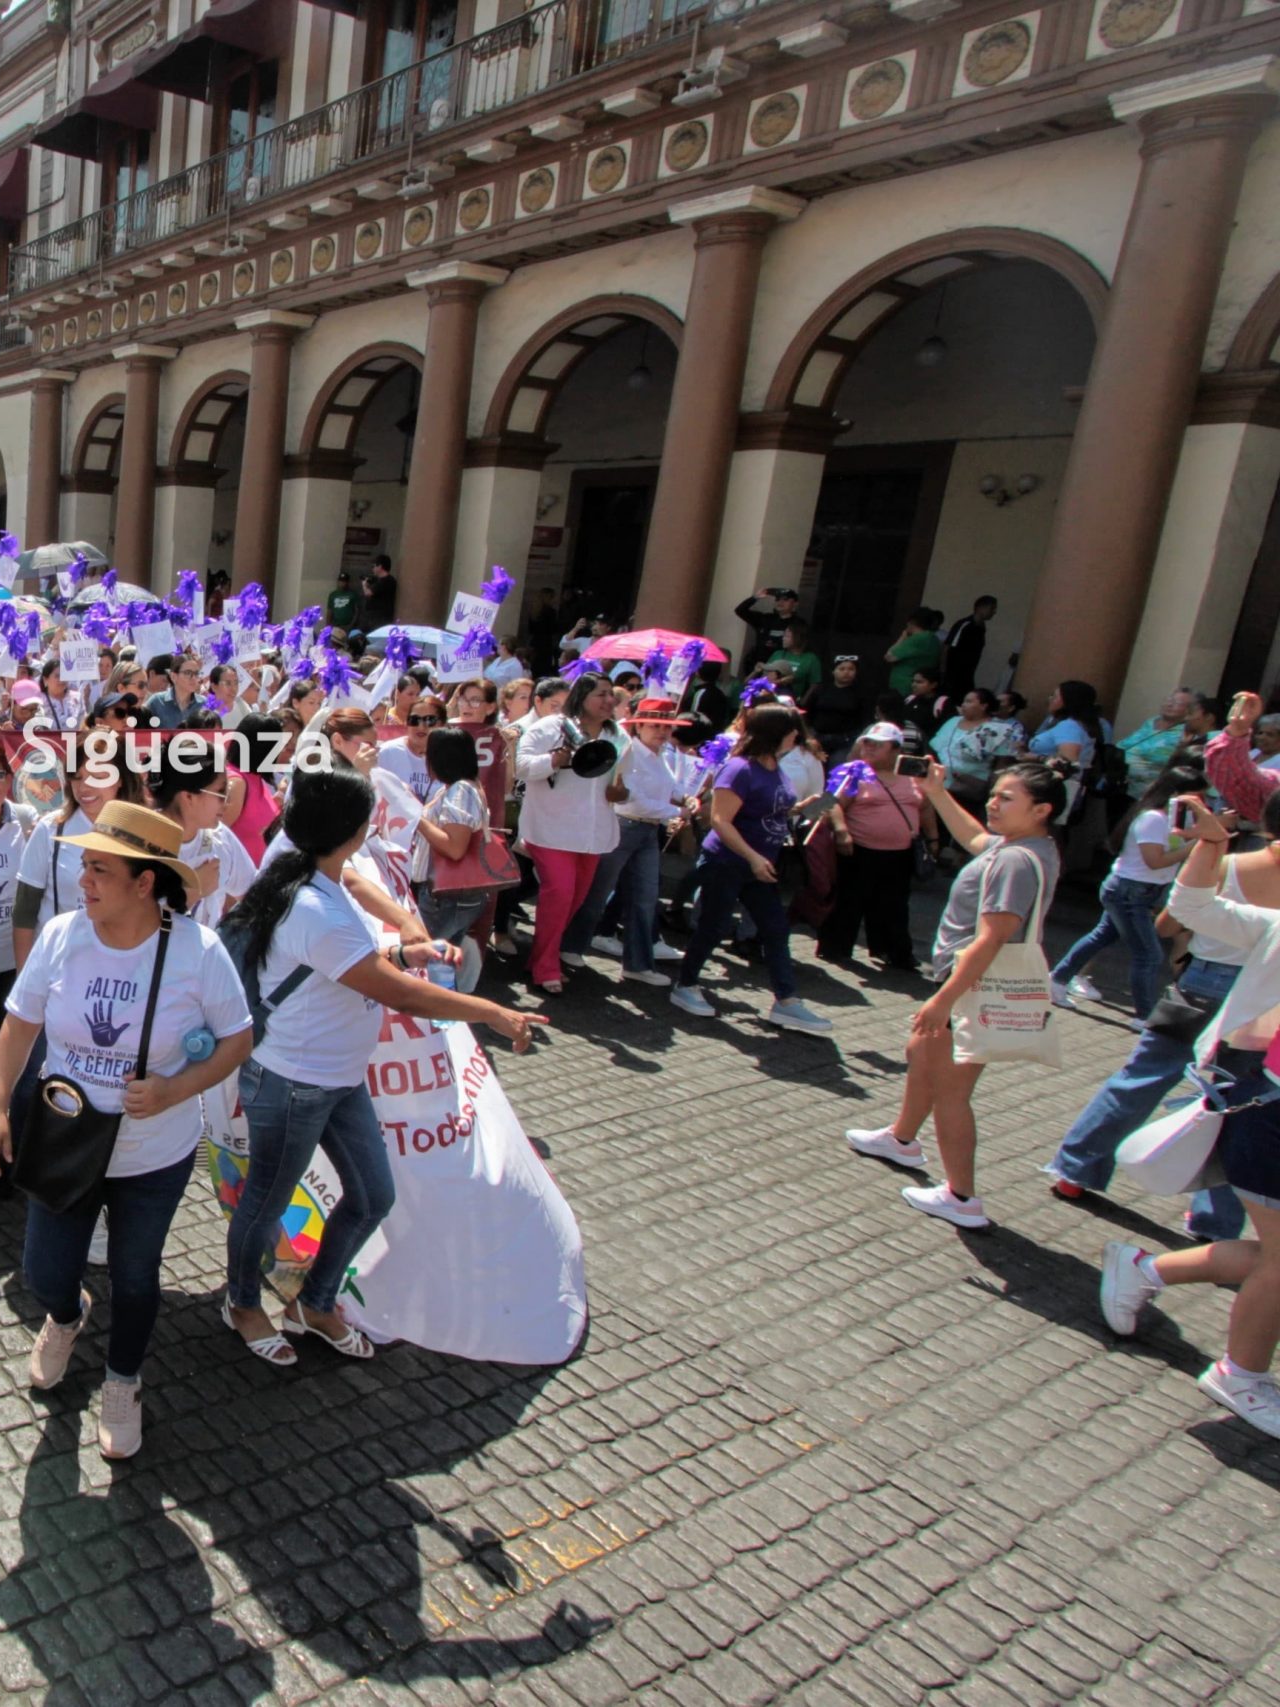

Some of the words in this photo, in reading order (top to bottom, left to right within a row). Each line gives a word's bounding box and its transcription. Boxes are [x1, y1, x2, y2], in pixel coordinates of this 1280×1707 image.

[85, 977, 137, 1003] ¡ALTO!
[65, 1050, 81, 1070] DE
[78, 1046, 112, 1056] VIOLENCIA
[367, 1050, 455, 1098] IOLE
